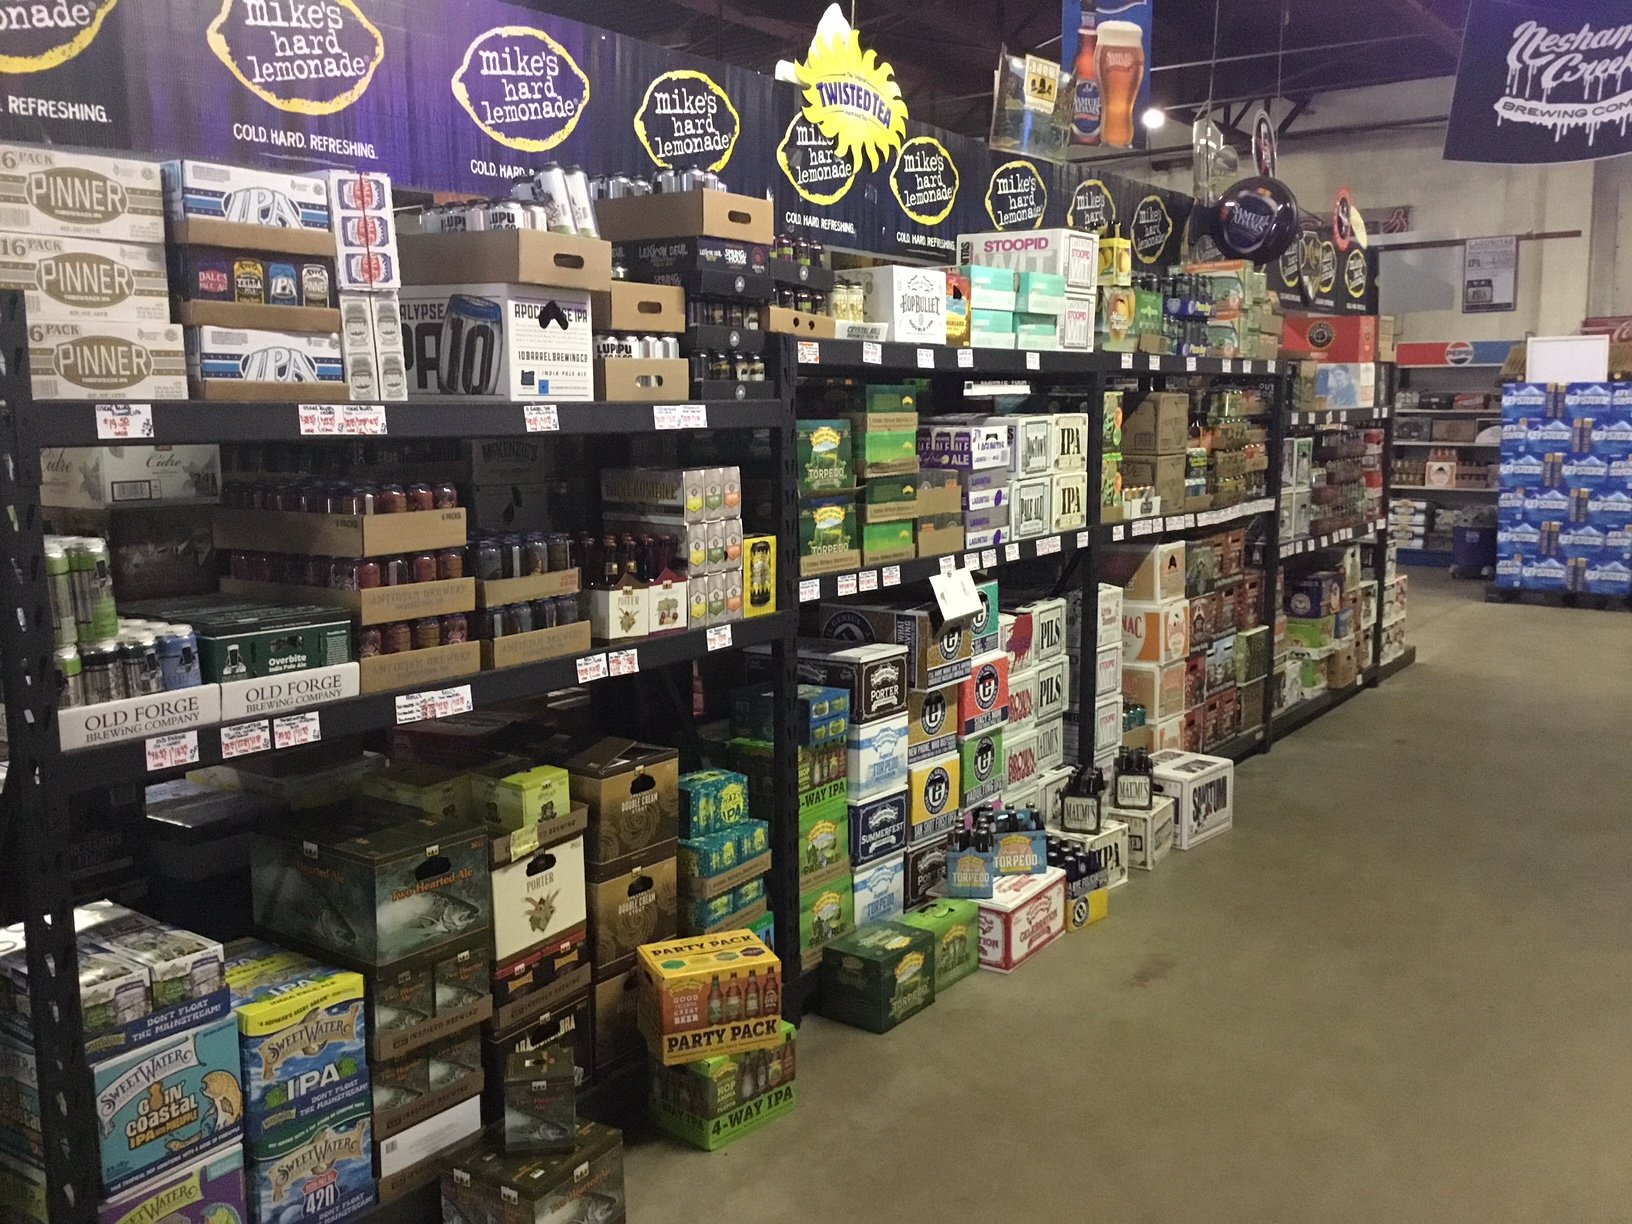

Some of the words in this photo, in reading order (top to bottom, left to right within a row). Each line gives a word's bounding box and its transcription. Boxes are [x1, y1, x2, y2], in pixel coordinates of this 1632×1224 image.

[246, 0, 343, 28] mike's
[275, 31, 342, 56] hard
[252, 55, 366, 84] lemonade
[479, 47, 559, 77] mike's
[502, 76, 558, 101] hard
[8, 95, 112, 123] REFRESHING.
[481, 98, 575, 125] lemonade
[655, 88, 718, 114] mike's
[816, 82, 871, 111] TWISTED
[873, 92, 891, 129] TEA
[1502, 102, 1588, 118] BREWING
[672, 116, 716, 137] hard
[233, 123, 268, 143] COLD.
[270, 130, 307, 149] HARD.
[309, 136, 379, 160] REFRESHING.
[655, 131, 730, 158] lemonade
[19, 152, 53, 165] PACK
[470, 159, 498, 177] COLD.
[904, 151, 944, 172] mike's
[796, 159, 852, 184] lemonade
[916, 172, 942, 189] hard
[31, 173, 122, 212] PINNER
[997, 175, 1036, 194] mike's
[904, 186, 952, 207] lemonade
[1009, 191, 1034, 210] hard
[226, 187, 305, 229] IPA
[1233, 203, 1271, 226] SAMUEL
[1232, 215, 1266, 234] ADAMS
[28, 240, 63, 251] PACK
[984, 237, 1048, 252] STOOPID
[40, 259, 130, 295] PINNER
[271, 280, 295, 294] IPA
[902, 295, 915, 314] HOP
[916, 297, 940, 315] BULLET
[575, 309, 588, 323] IPA
[45, 324, 80, 336] PACK
[58, 345, 148, 376] PINNER
[244, 346, 319, 382] IPA
[526, 351, 551, 362] BARREL
[552, 351, 580, 363] BREWING
[1061, 428, 1080, 455] IPA
[951, 455, 969, 466] ALE
[809, 468, 844, 480] TORPEDO
[1061, 487, 1080, 515] IPA
[812, 542, 848, 555] TORPEDO
[1040, 616, 1060, 650] PILS
[269, 654, 306, 666] Overbite
[246, 685, 281, 702] OLD
[288, 675, 342, 693] FORGE
[295, 688, 343, 704] COMPANY
[871, 685, 899, 701] PORTER
[1040, 674, 1061, 707] PILS
[85, 710, 128, 731] OLD
[135, 697, 199, 720] FORGE
[145, 712, 200, 732] COMPANY
[828, 781, 845, 798] IPA
[723, 807, 741, 821] IPA
[861, 822, 904, 845] SUMMERFEST
[994, 854, 1037, 867] TORPEDO
[391, 887, 413, 902] Two
[417, 873, 455, 892] Hearted
[456, 867, 473, 883] Ale
[526, 872, 554, 894] PORTER
[918, 866, 947, 887] PORTER
[952, 872, 990, 883] TORPEDO
[651, 942, 705, 957] PARTY
[712, 936, 753, 948] PACK
[674, 994, 698, 1004] GOOD
[147, 1010, 175, 1027] DON'T
[178, 999, 208, 1018] FLOAT
[674, 1007, 699, 1016] GREAT
[674, 1015, 699, 1025] BEER
[132, 1028, 152, 1043] THE
[155, 1003, 221, 1037] MAINSTREAM!
[667, 1029, 726, 1053] PARTY
[731, 1019, 777, 1039] PACK
[287, 1063, 340, 1101] IPA
[311, 1088, 333, 1103] DON'T
[334, 1079, 358, 1093] FLOAT
[717, 1081, 736, 1096] HOP
[300, 1105, 315, 1117] THE
[712, 1104, 764, 1135] 4-WAY
[767, 1086, 793, 1109] IPA
[129, 1129, 155, 1151] IPA
[306, 1184, 335, 1215] 420
